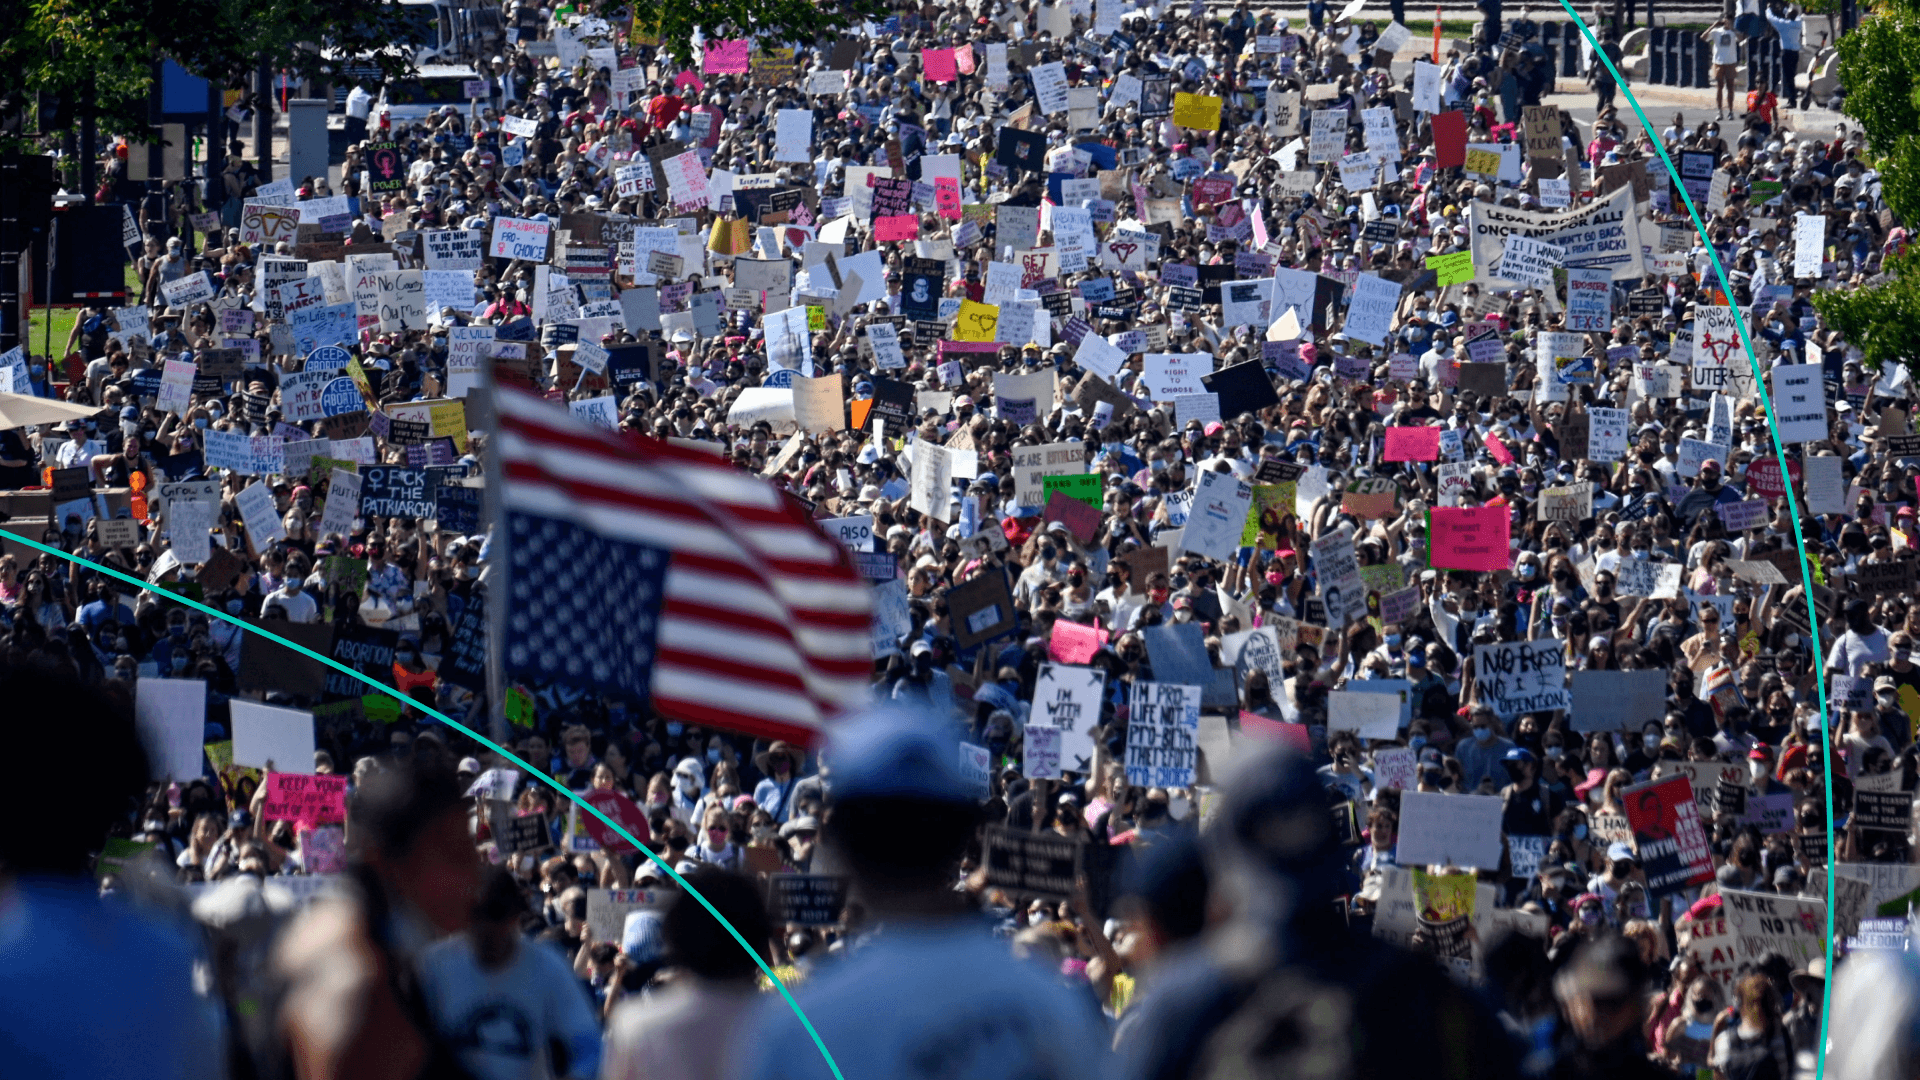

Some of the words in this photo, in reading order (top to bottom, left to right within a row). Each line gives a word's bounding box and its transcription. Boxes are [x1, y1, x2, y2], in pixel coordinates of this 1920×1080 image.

[1525, 107, 1556, 122] VIVA
[1536, 123, 1550, 133] LA
[367, 143, 396, 151] WOMEN
[373, 180, 402, 189] POWER
[1487, 208, 1534, 227] LEGAL
[1538, 200, 1611, 228] ABORTION
[1477, 224, 1518, 239] ONCE
[1524, 226, 1555, 238] AND
[1560, 218, 1589, 232] FOR
[1594, 211, 1624, 224] ALL!
[245, 231, 258, 242] ON
[278, 235, 291, 243] ME
[1558, 234, 1582, 246] WON'T
[1584, 231, 1596, 242] GO
[1600, 226, 1625, 239] BACK
[513, 242, 545, 260] CHOICE
[1572, 244, 1594, 255] FIGHT
[1598, 239, 1626, 251] BACK!
[264, 262, 273, 272] IF
[275, 263, 278, 272] I
[280, 262, 307, 272] WANTED
[912, 258, 937, 268] FIGHT
[1023, 253, 1050, 266] GET
[294, 283, 309, 299] I
[378, 275, 393, 292] No
[284, 295, 322, 315] MARCH
[381, 303, 399, 322] Old
[401, 307, 423, 318] Men
[1696, 308, 1723, 321] MIND
[1572, 316, 1604, 329] TEXAS
[1708, 317, 1735, 328] OWN
[452, 329, 466, 340] WE
[470, 329, 493, 339] WILL
[315, 350, 344, 360] KEEP
[454, 343, 474, 353] NOT
[476, 343, 492, 353] GO
[1637, 368, 1653, 381] SHE
[1786, 377, 1809, 386] ABORT
[1027, 453, 1042, 466] ARE
[1046, 449, 1083, 465] RUTHLESS
[332, 485, 360, 498] RUTH
[388, 487, 422, 499] THE
[362, 498, 437, 518] PATRIARCHY
[1157, 686, 1190, 705] PRO-
[1047, 702, 1082, 718] WITH
[1131, 704, 1157, 724] LIFE
[1160, 705, 1184, 725] NOT
[1722, 766, 1743, 780] NO
[1675, 801, 1695, 817] WE
[1675, 817, 1699, 834] ARE
[1678, 846, 1707, 867] NOW
[1649, 876, 1663, 888] ACT
[1665, 864, 1712, 883] ACCORDINGLY
[608, 891, 655, 903] TEXAS
[1760, 917, 1796, 936] NOT
